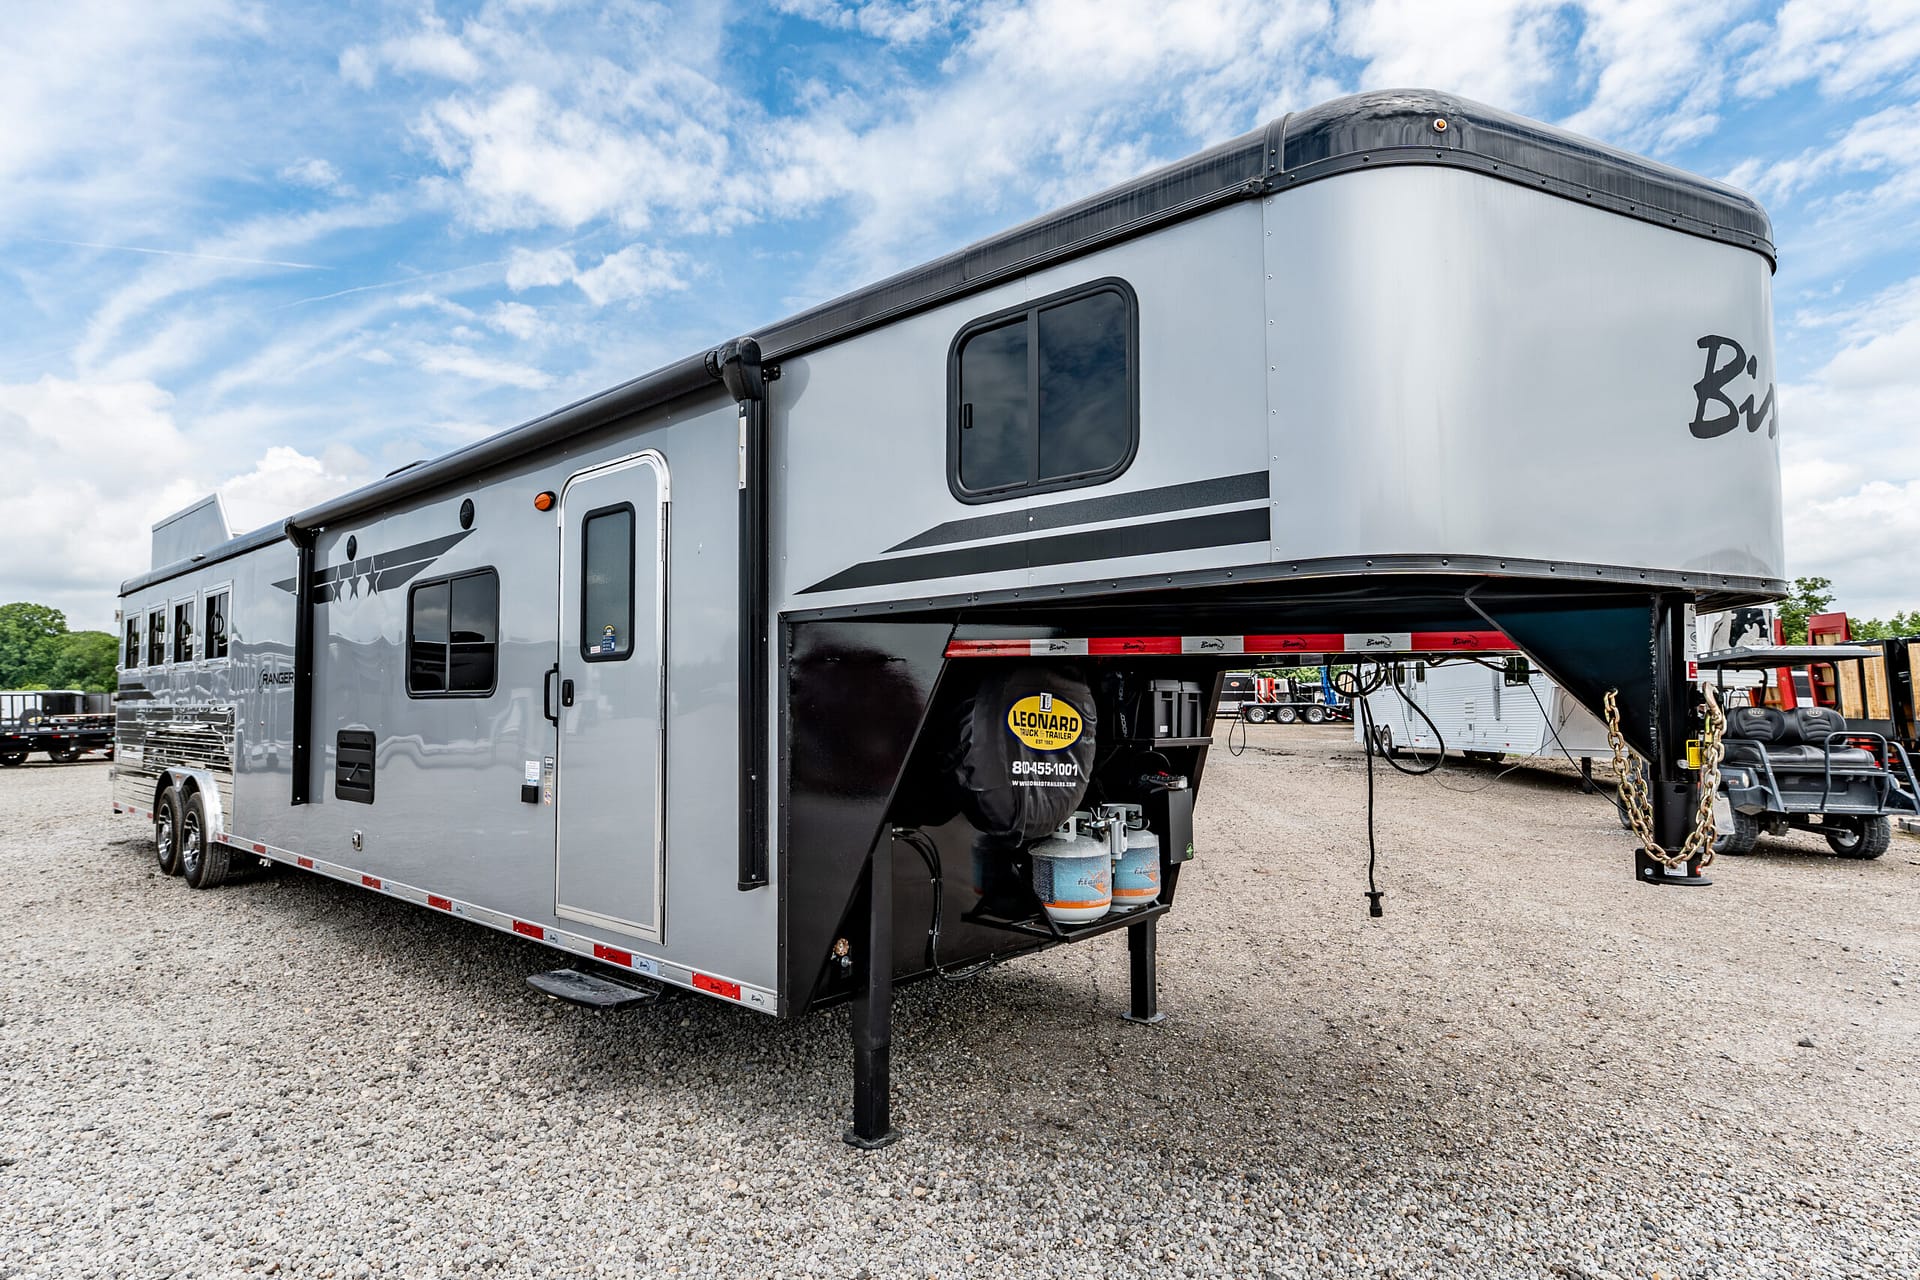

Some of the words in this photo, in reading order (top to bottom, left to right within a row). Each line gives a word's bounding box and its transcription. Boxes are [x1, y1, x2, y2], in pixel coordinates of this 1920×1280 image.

[263, 671, 294, 685] RANGER
[1012, 710, 1079, 732] LEONARD
[1045, 731, 1072, 740] TRAILER
